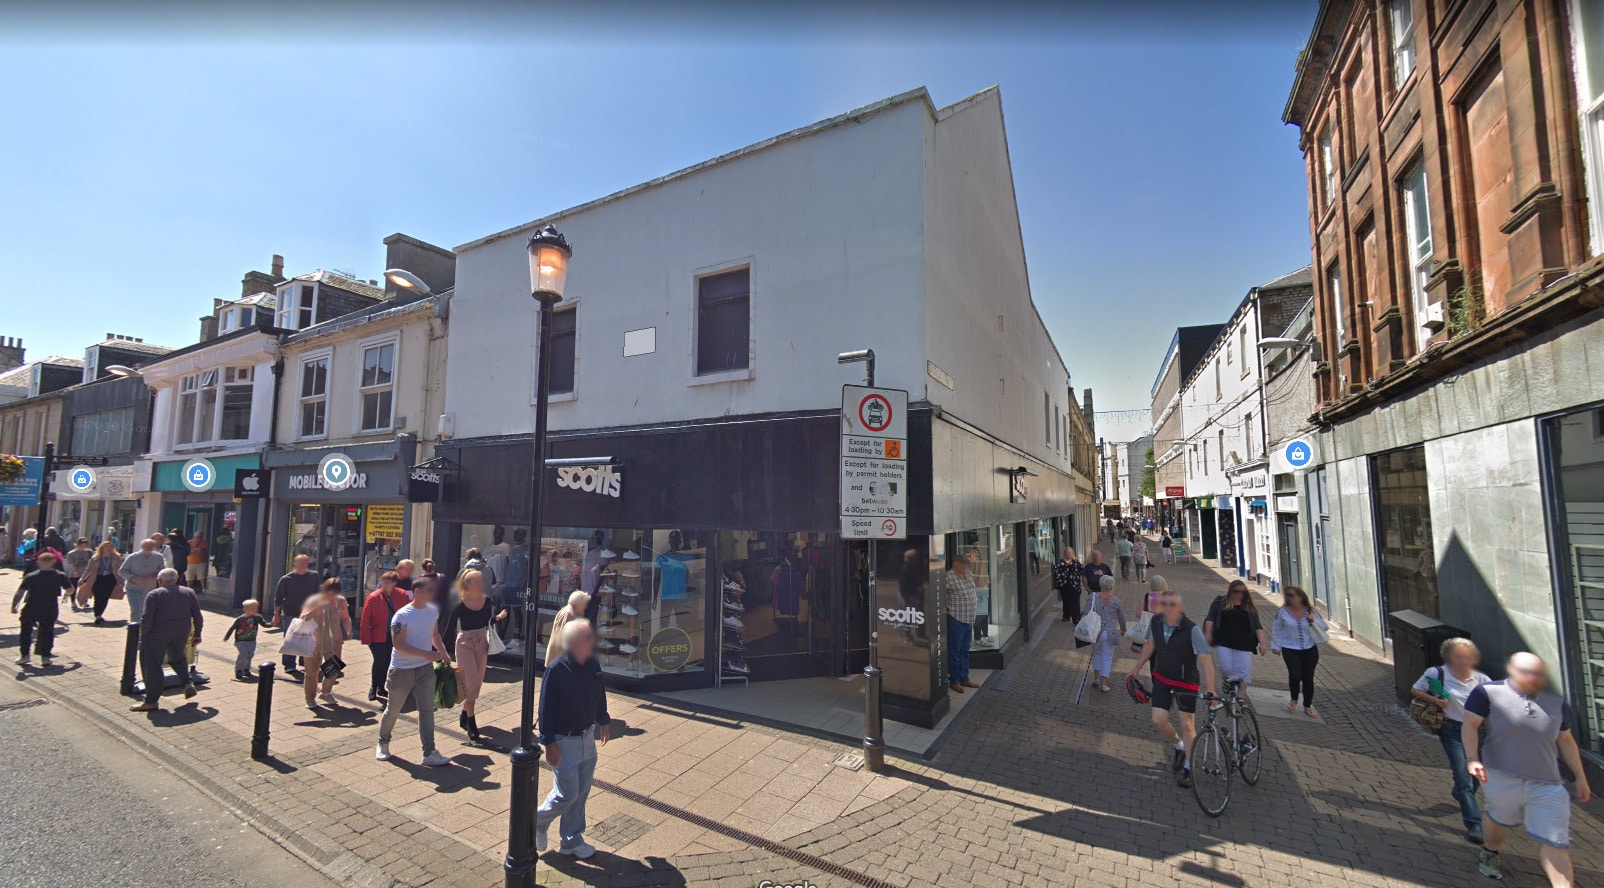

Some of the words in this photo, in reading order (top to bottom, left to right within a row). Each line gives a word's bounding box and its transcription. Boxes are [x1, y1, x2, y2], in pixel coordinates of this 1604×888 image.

[849, 438, 871, 447] Except
[848, 447, 872, 455] loading
[844, 461, 867, 469] Except
[882, 463, 905, 471] loading
[288, 474, 323, 489] MOBILE
[324, 472, 367, 489] TOR
[410, 472, 440, 484] scotts
[557, 465, 621, 498] scotts
[851, 520, 872, 528] Speed
[526, 587, 532, 596] R
[878, 606, 925, 625] scotts
[651, 644, 688, 655] OFFERS
